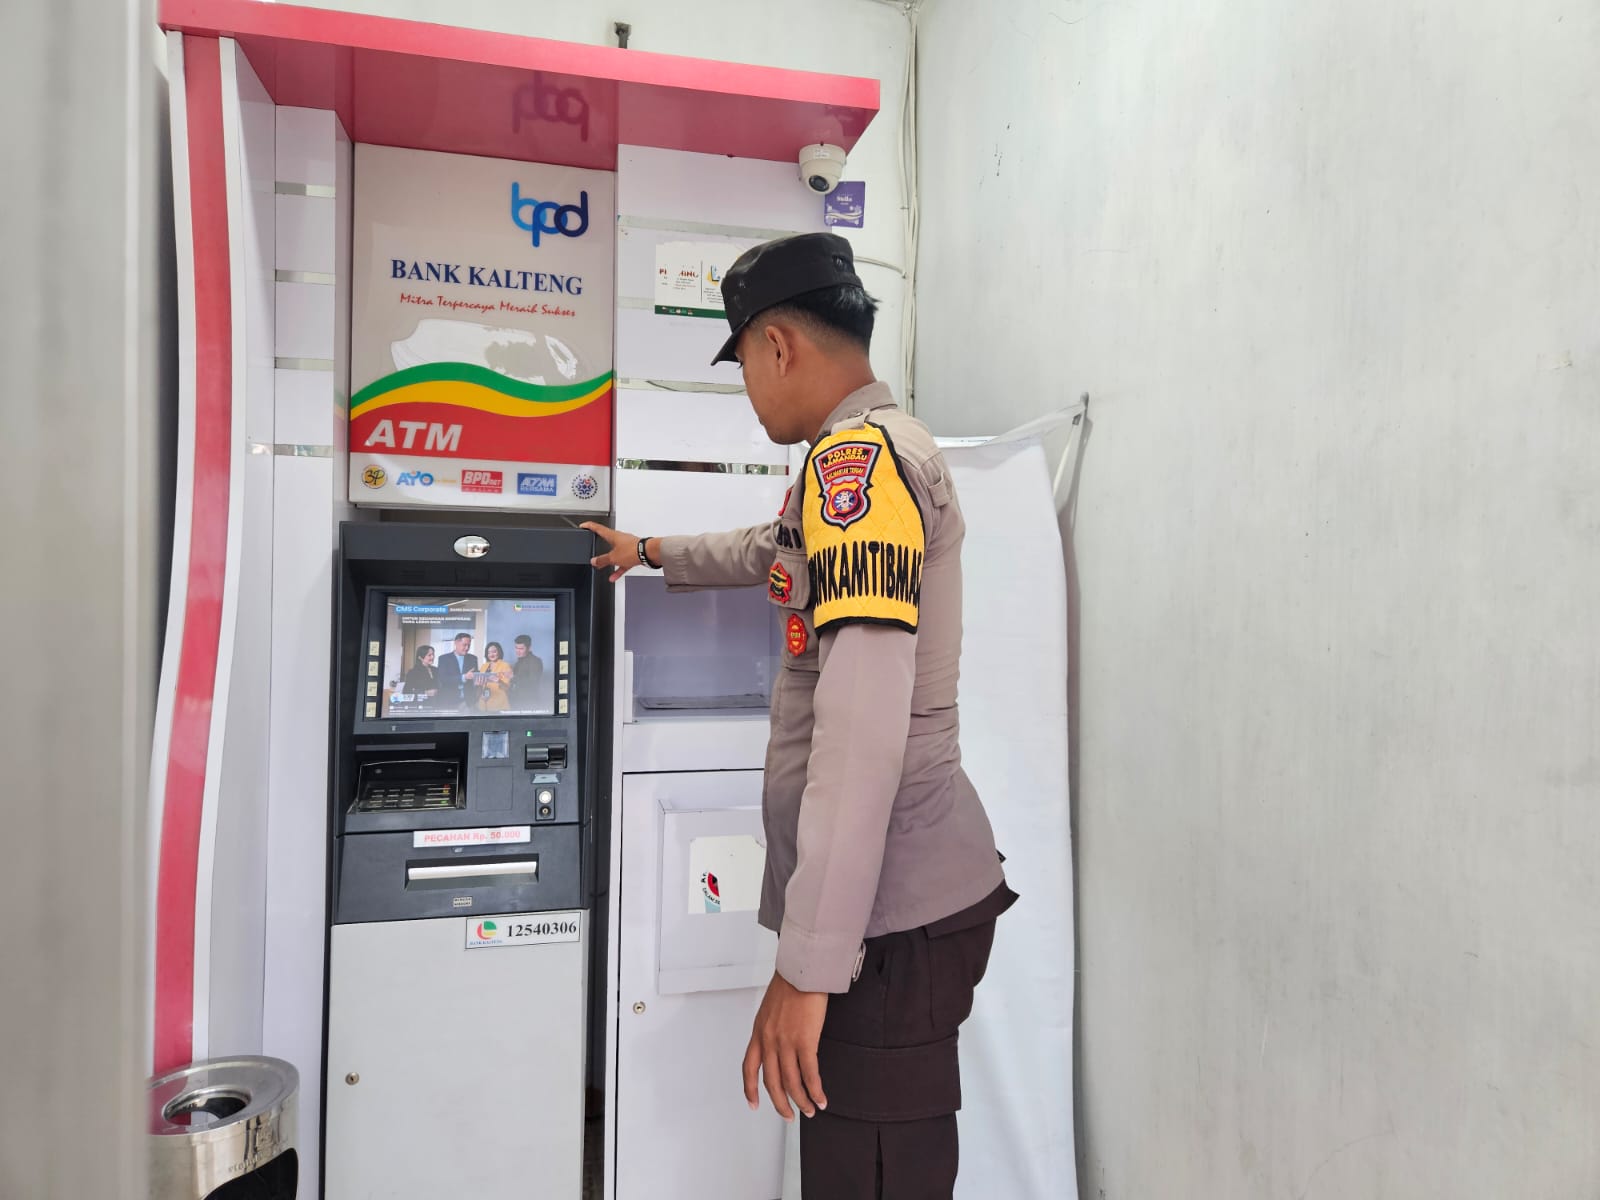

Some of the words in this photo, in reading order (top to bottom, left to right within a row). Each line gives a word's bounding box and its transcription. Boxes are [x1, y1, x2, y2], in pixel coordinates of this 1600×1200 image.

[511, 182, 589, 247] bpd
[391, 259, 461, 284] BANK
[468, 266, 583, 296] KALTENG
[400, 292, 434, 306] Mitra
[437, 296, 495, 314] Terpercaya
[500, 301, 537, 315] Meraih
[542, 304, 577, 318] Sukses
[364, 419, 463, 452] ATM
[827, 448, 863, 460] POLRES
[396, 471, 434, 486] AYO
[463, 471, 491, 486] BPD
[413, 606, 446, 614] Corporate
[424, 833, 470, 843] PECAHAN
[490, 831, 520, 840] 50.000
[507, 920, 577, 938] 12540306
